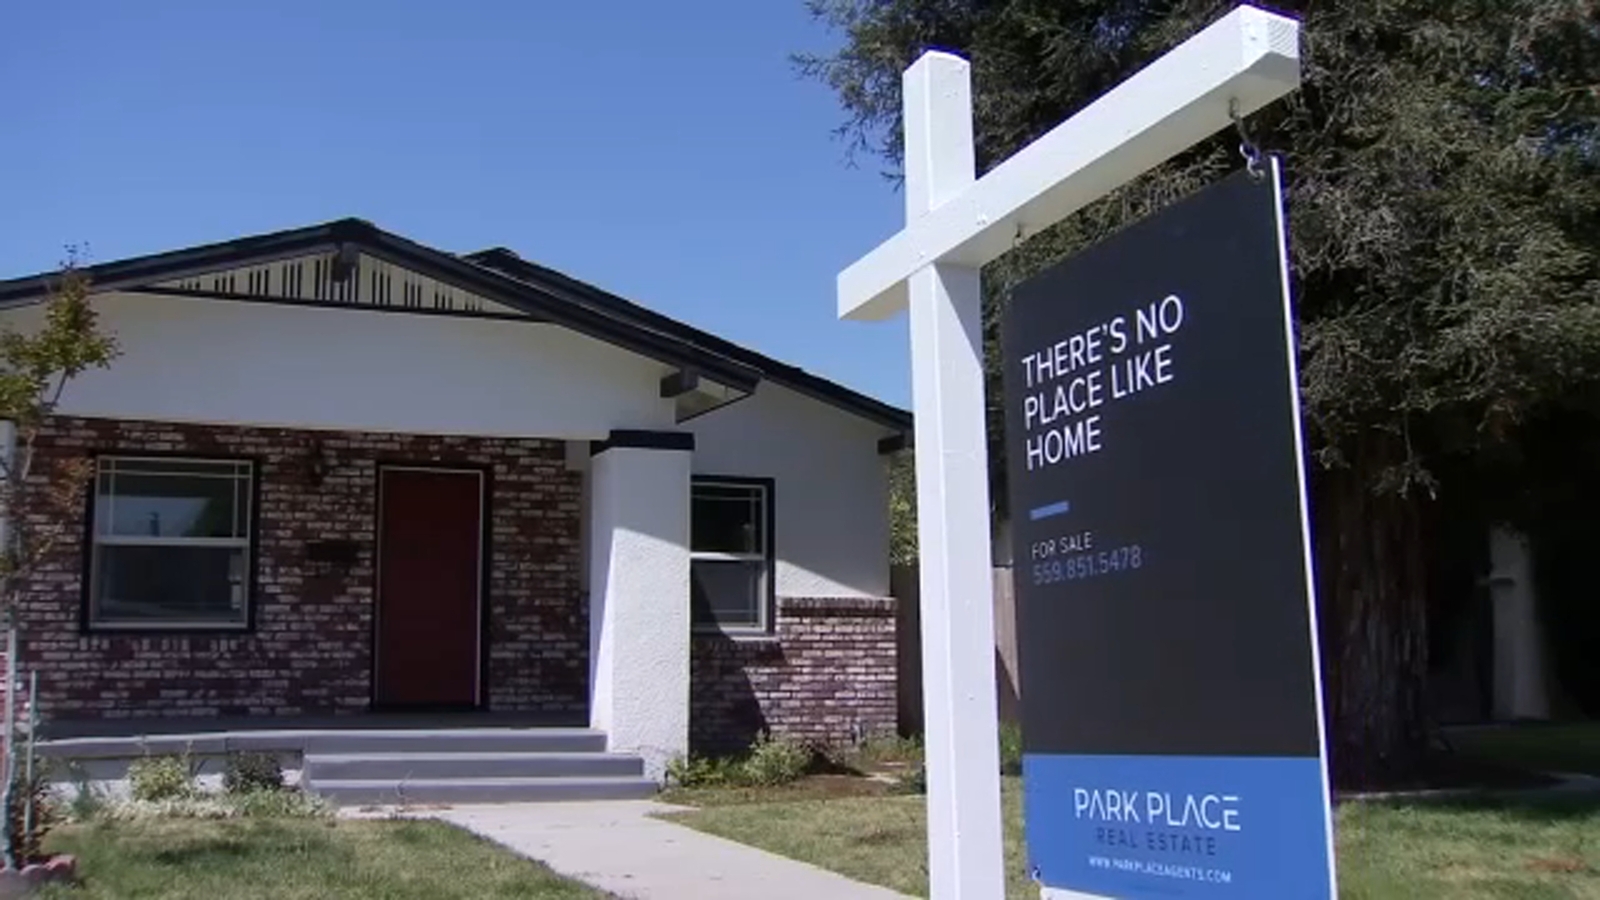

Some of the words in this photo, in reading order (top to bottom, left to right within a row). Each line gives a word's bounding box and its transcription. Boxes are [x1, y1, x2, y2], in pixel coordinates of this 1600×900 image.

[1021, 316, 1128, 388] THERE'S
[1136, 294, 1184, 344] NO
[1023, 370, 1104, 431] PLACE
[1111, 344, 1174, 399] LIKE
[1026, 415, 1102, 471] HOME
[1031, 539, 1056, 560] FOR
[1059, 531, 1093, 554] SALE
[1033, 544, 1143, 586] 559.851.5478
[1073, 788, 1142, 823] PARK
[1146, 792, 1242, 831] PLACE
[1096, 826, 1138, 849] REAL
[1146, 831, 1217, 856] ESTATE
[1087, 855, 1233, 883] WWW.PARKPLACEAGENTS.COM
